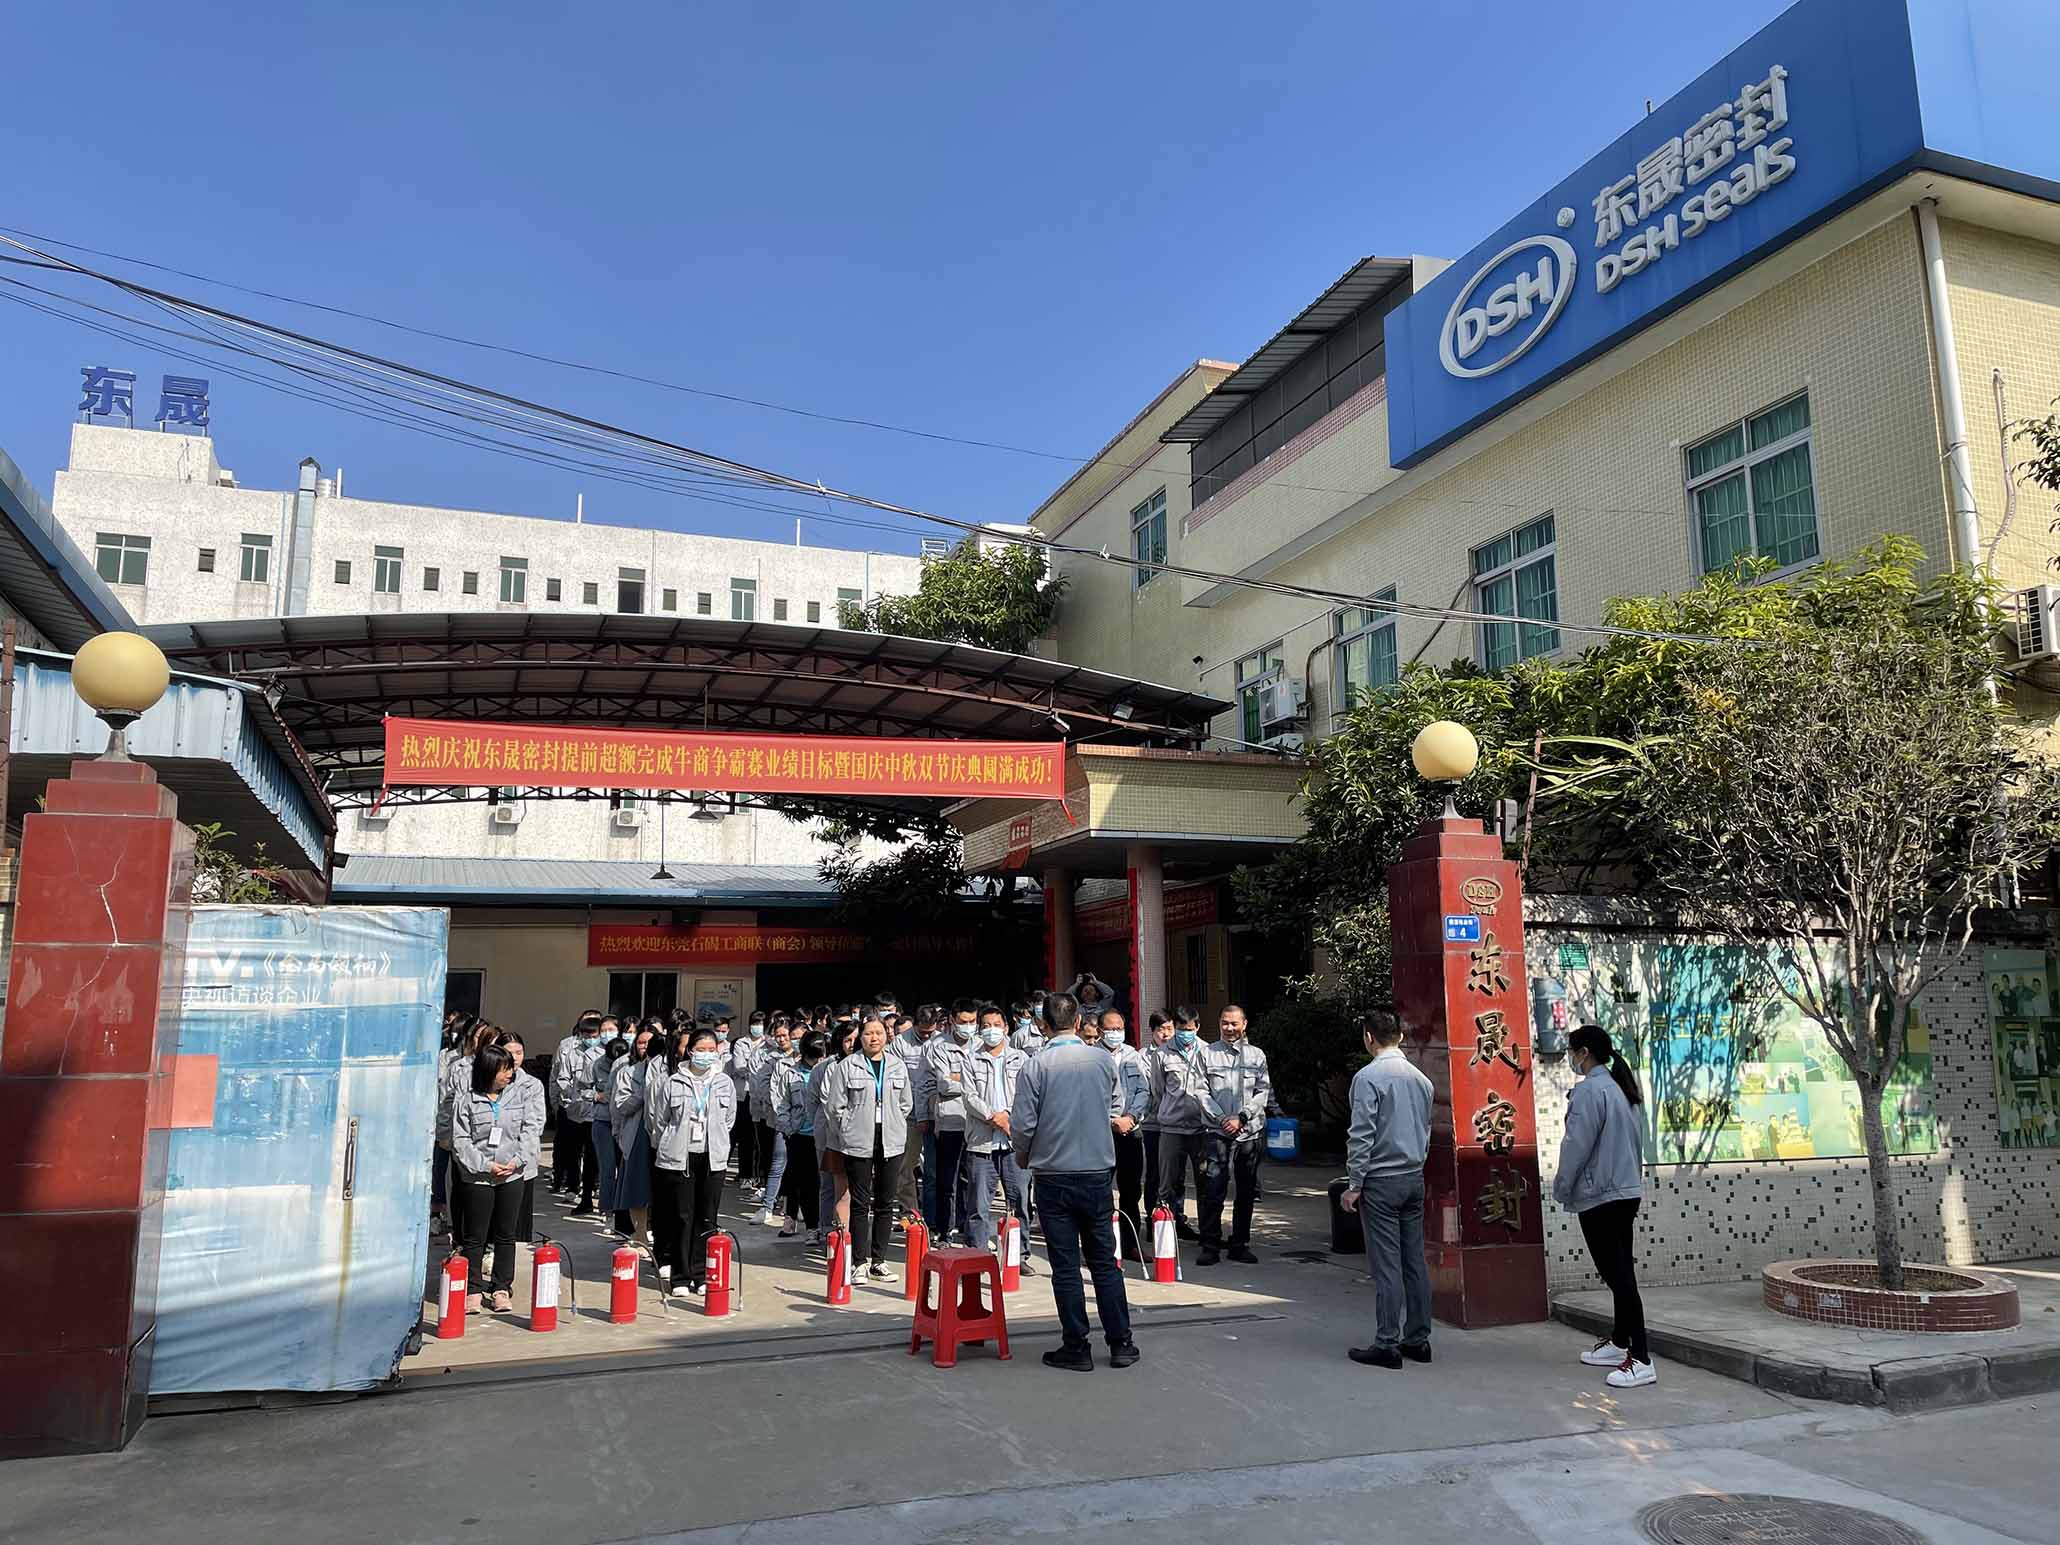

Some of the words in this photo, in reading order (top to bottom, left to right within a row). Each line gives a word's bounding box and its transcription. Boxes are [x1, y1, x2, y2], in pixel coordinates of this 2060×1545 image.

[1592, 64, 1788, 248] 东晟密封
[1595, 213, 1680, 294] DSH
[1681, 137, 1796, 238] seals
[1456, 256, 1554, 359] DSH
[78, 366, 210, 426] 东晟
[1468, 929, 1530, 1231] 东晟密封
